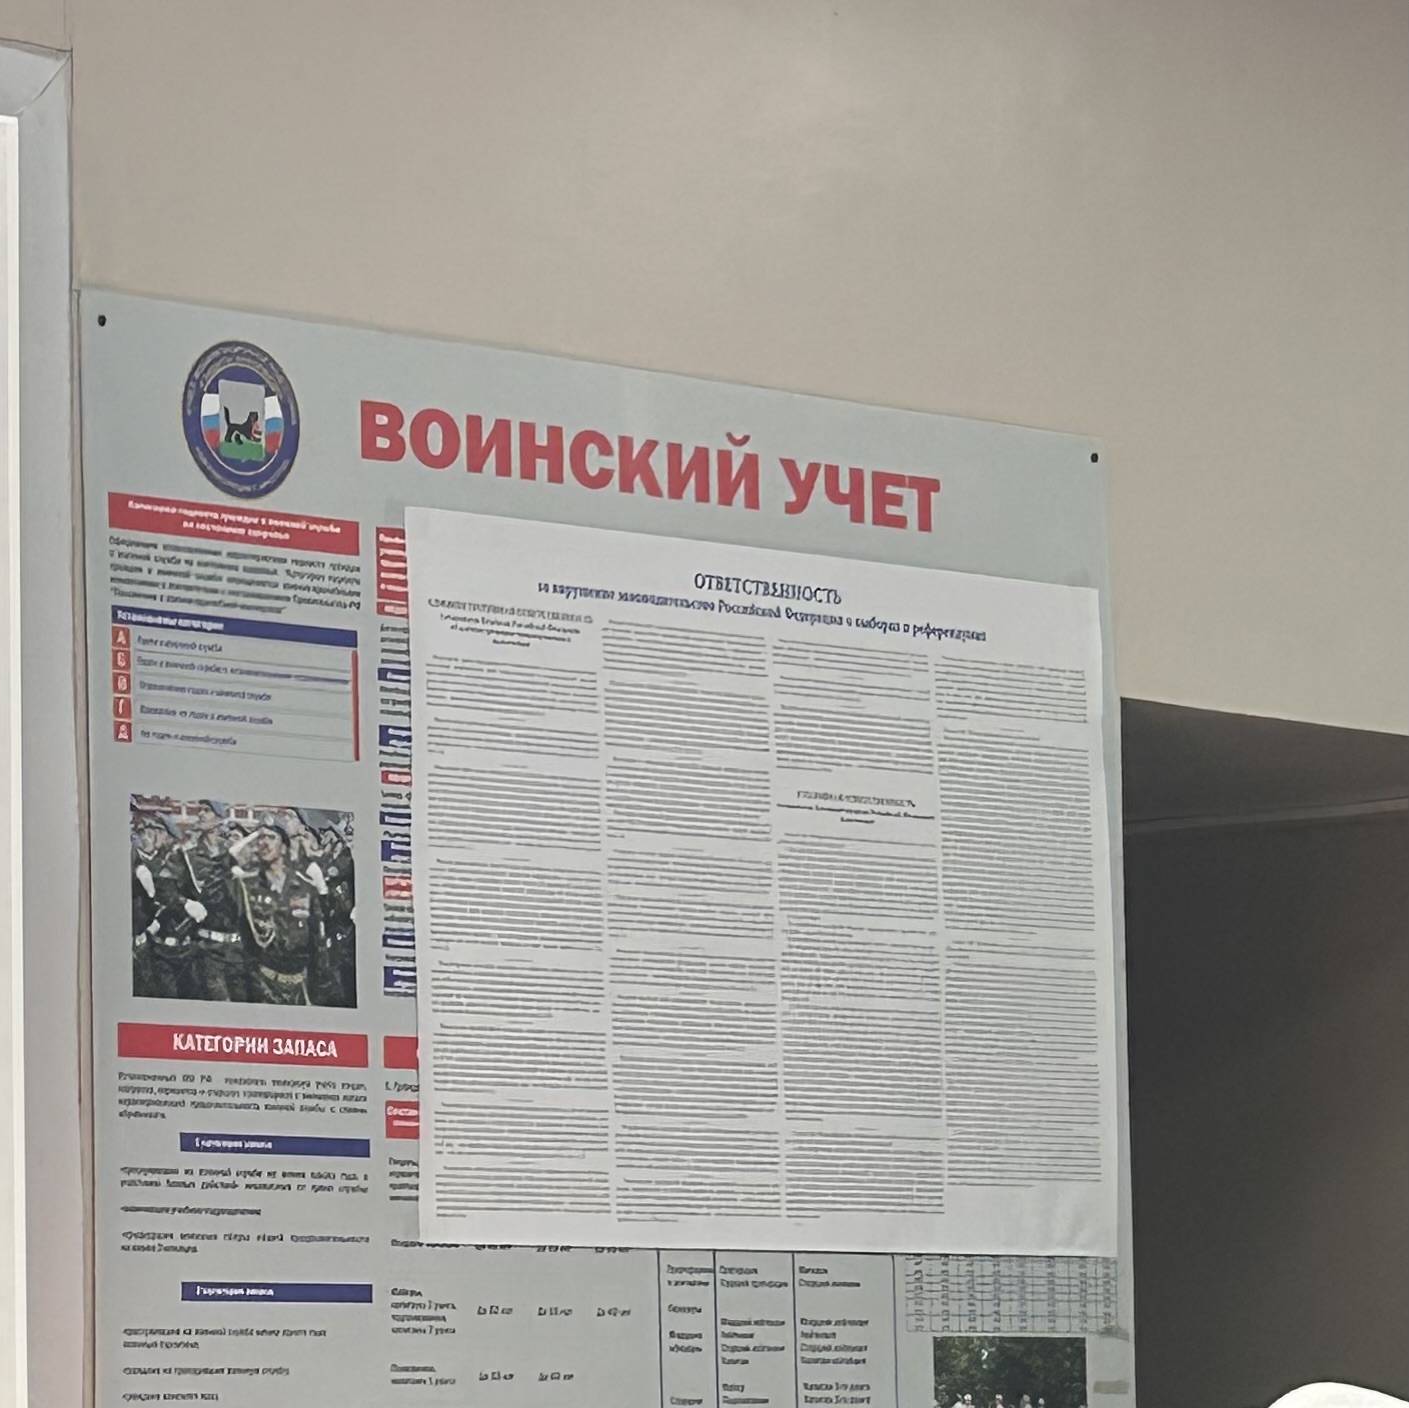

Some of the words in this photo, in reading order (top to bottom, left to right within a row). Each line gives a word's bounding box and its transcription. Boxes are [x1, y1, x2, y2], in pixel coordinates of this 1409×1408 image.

[360, 400, 760, 510] ВОИНСКИЙ
[781, 458, 941, 532] УЧЕТ
[694, 573, 842, 605] ОТВЕТСТВЕННОСТЬ
[173, 1033, 269, 1056] КАТЕГОРИИ
[273, 1038, 338, 1058] ЗАПАСА
